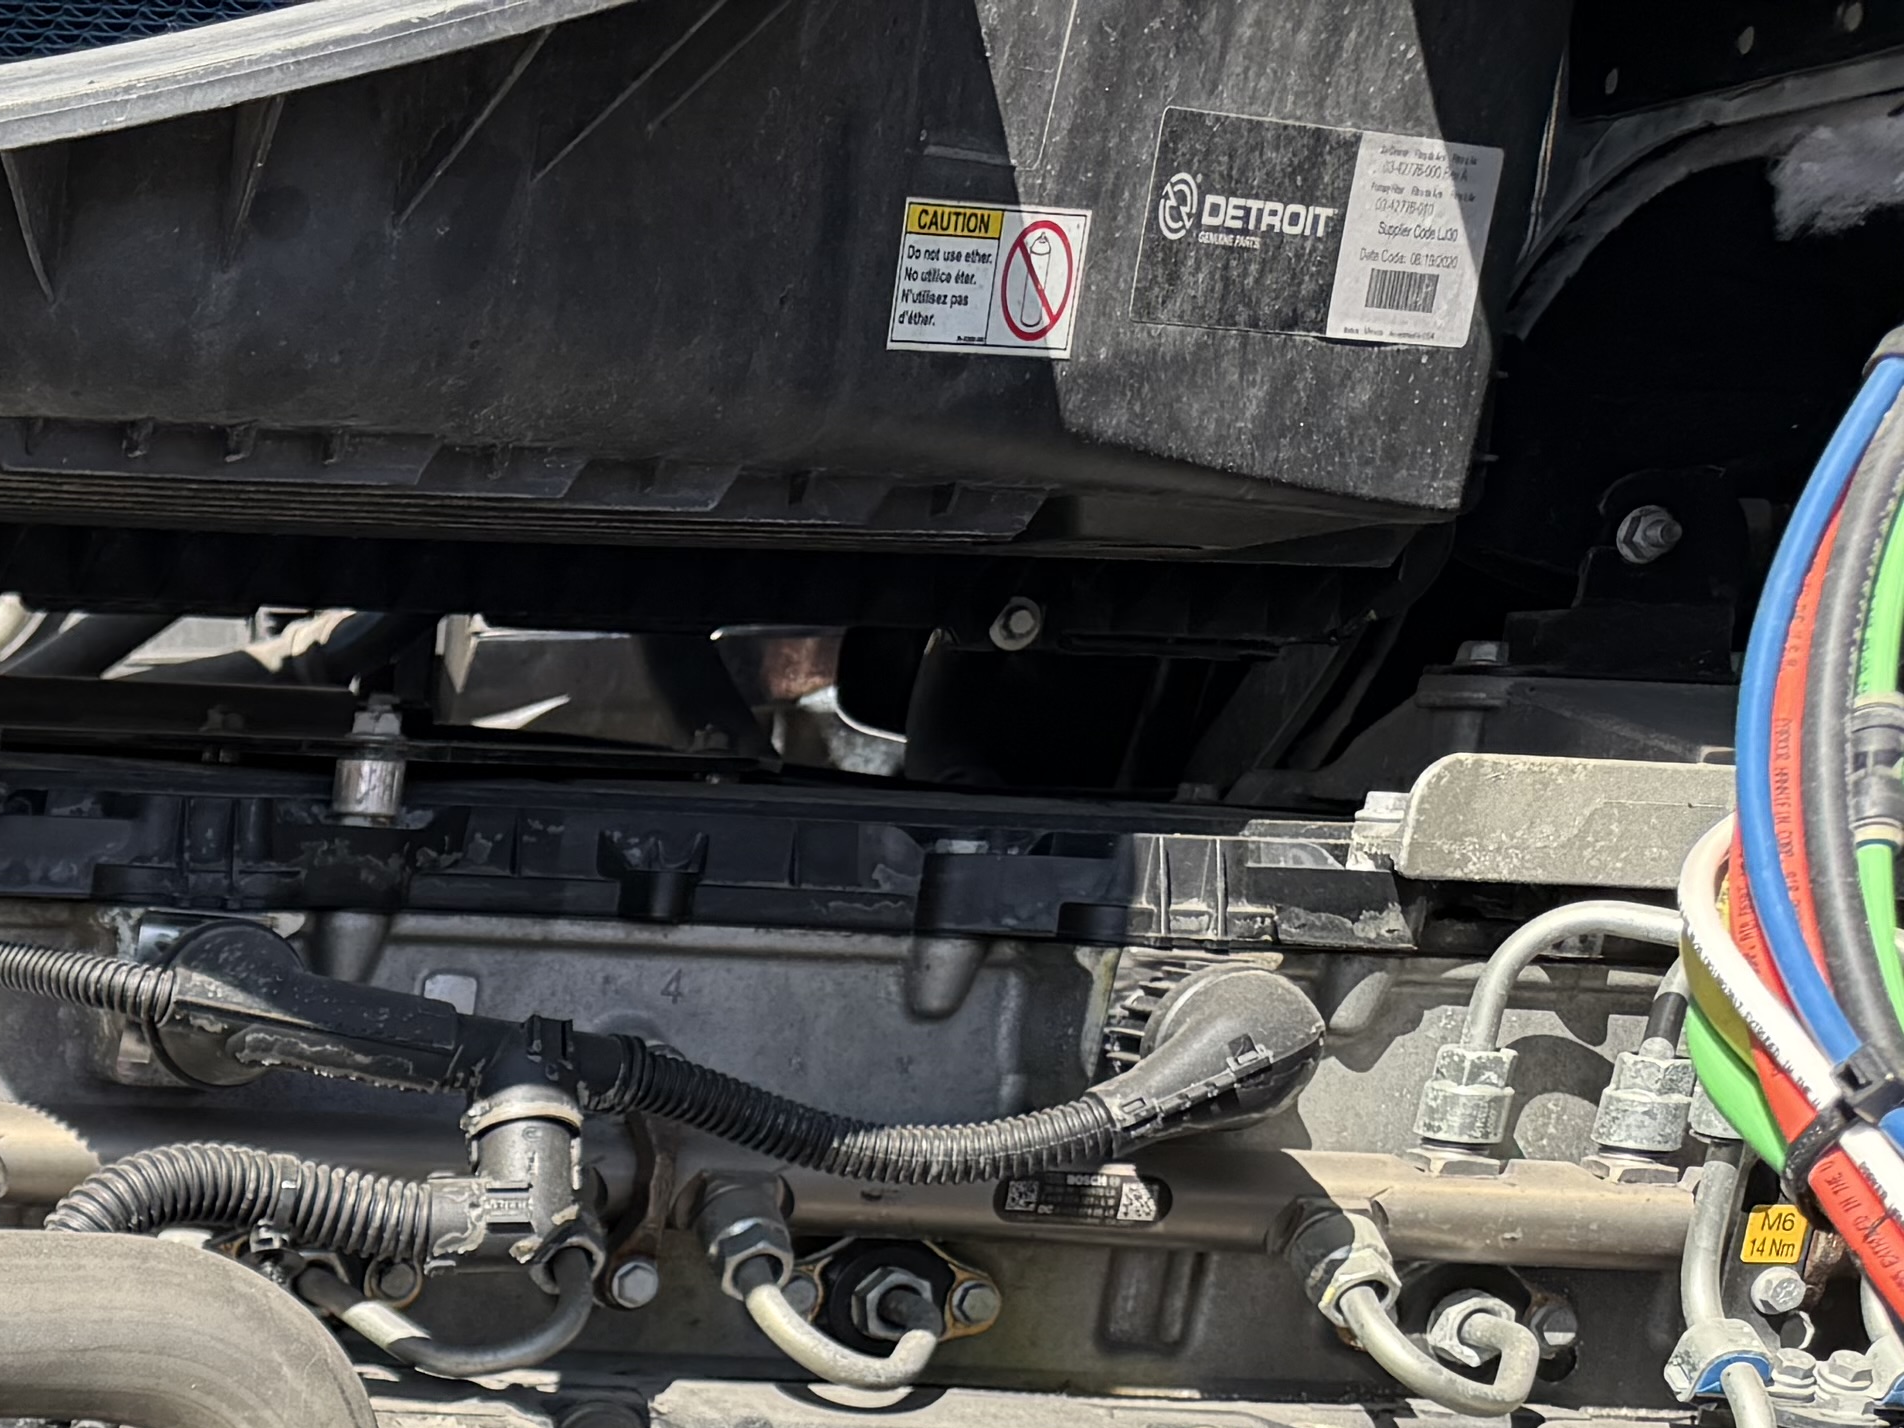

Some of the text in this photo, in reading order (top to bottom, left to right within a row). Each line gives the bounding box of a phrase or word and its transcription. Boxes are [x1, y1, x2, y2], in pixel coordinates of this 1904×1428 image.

[918, 209, 990, 233] CAUTION
[1201, 194, 1338, 237] DETROIT
[1378, 221, 1436, 240] Supplier Code
[907, 245, 992, 264] Do not use ether.
[1360, 248, 1379, 261] Date
[904, 267, 977, 285] No utilice éter.
[902, 289, 969, 309] N'utilisez pas
[898, 311, 935, 326] d'éther.
[660, 967, 684, 1005] 4
[1067, 1175, 1107, 1186] BOSCH
[1761, 1212, 1795, 1231] M6
[1749, 1238, 1795, 1257] 14 Nm
